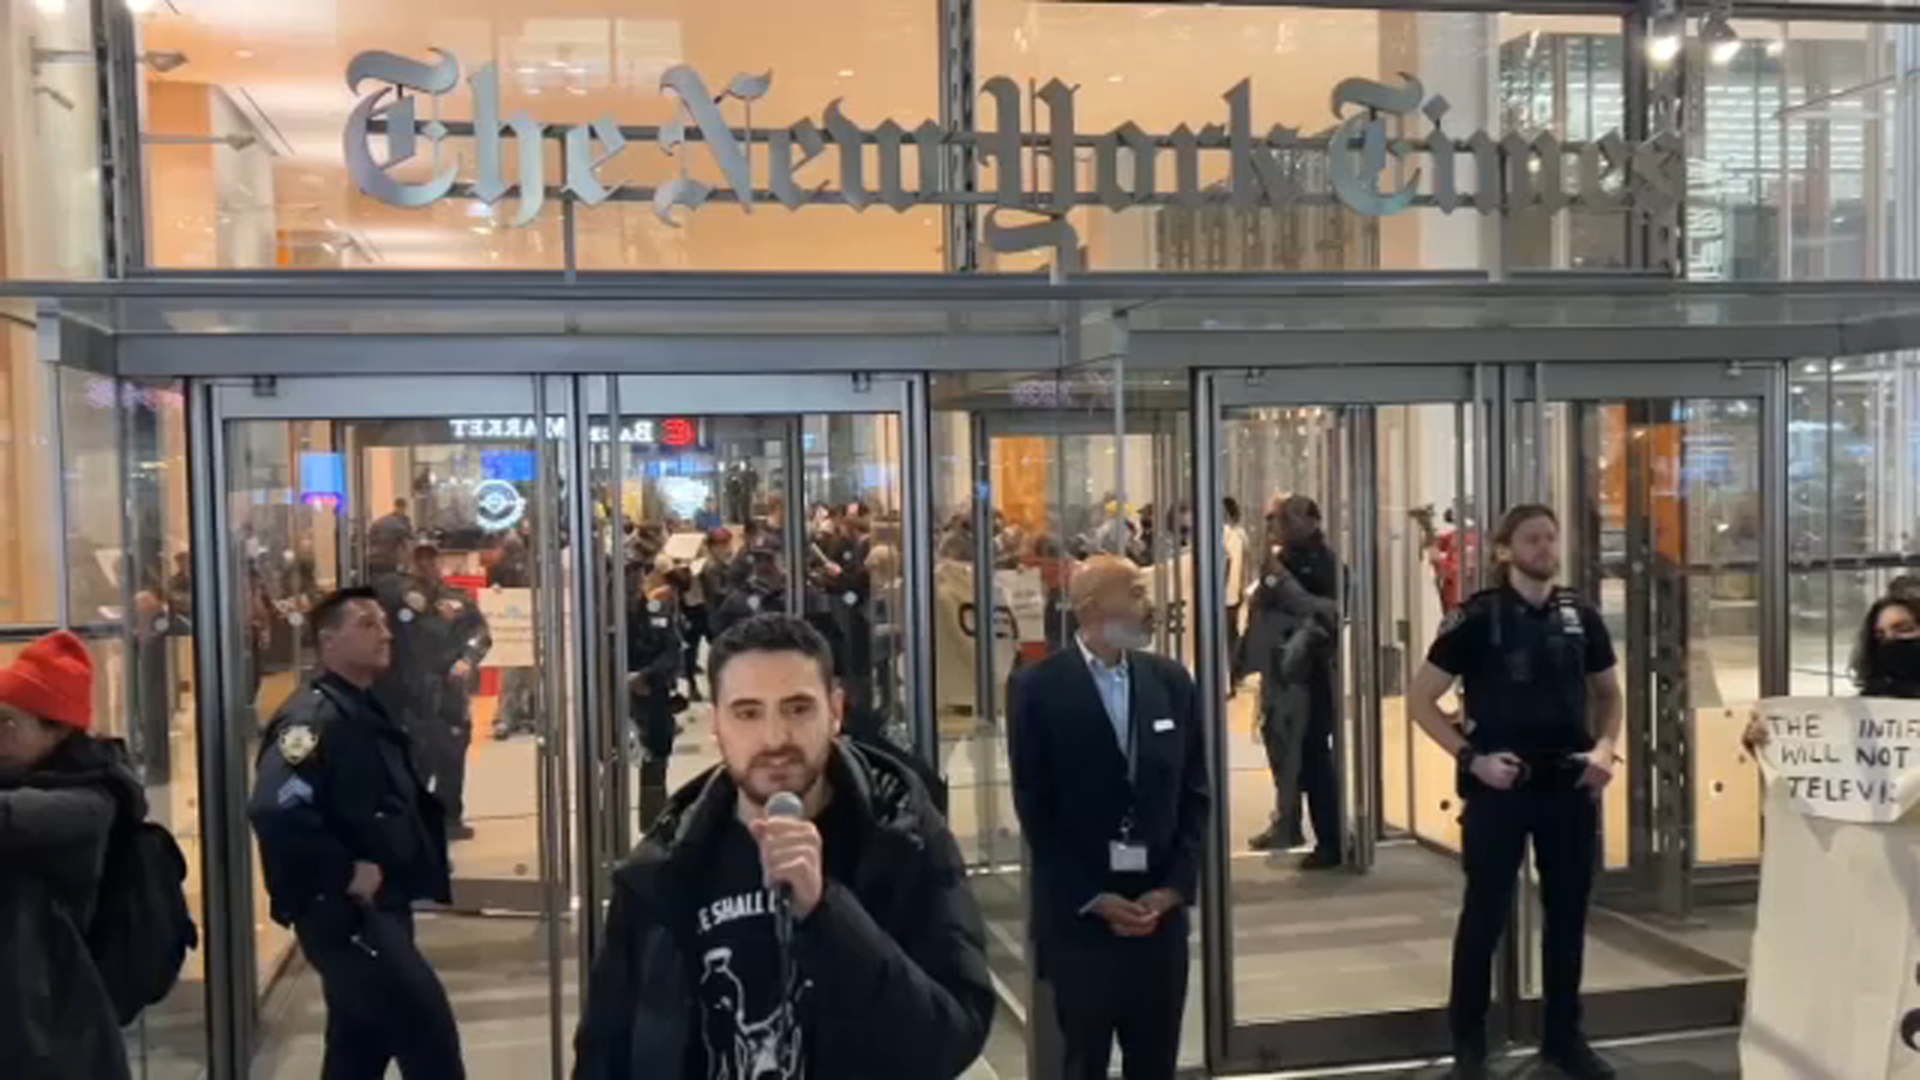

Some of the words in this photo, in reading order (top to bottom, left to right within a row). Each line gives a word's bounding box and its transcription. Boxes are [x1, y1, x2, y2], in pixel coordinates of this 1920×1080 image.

[343, 47, 624, 228] The
[653, 63, 948, 227] New
[976, 76, 1301, 272] York
[1329, 71, 1685, 217] Times
[1766, 714, 1822, 738] THE
[1781, 743, 1841, 765] WILL
[1856, 746, 1911, 769] NOT
[698, 907, 712, 932] E
[711, 890, 765, 926] SHALL
